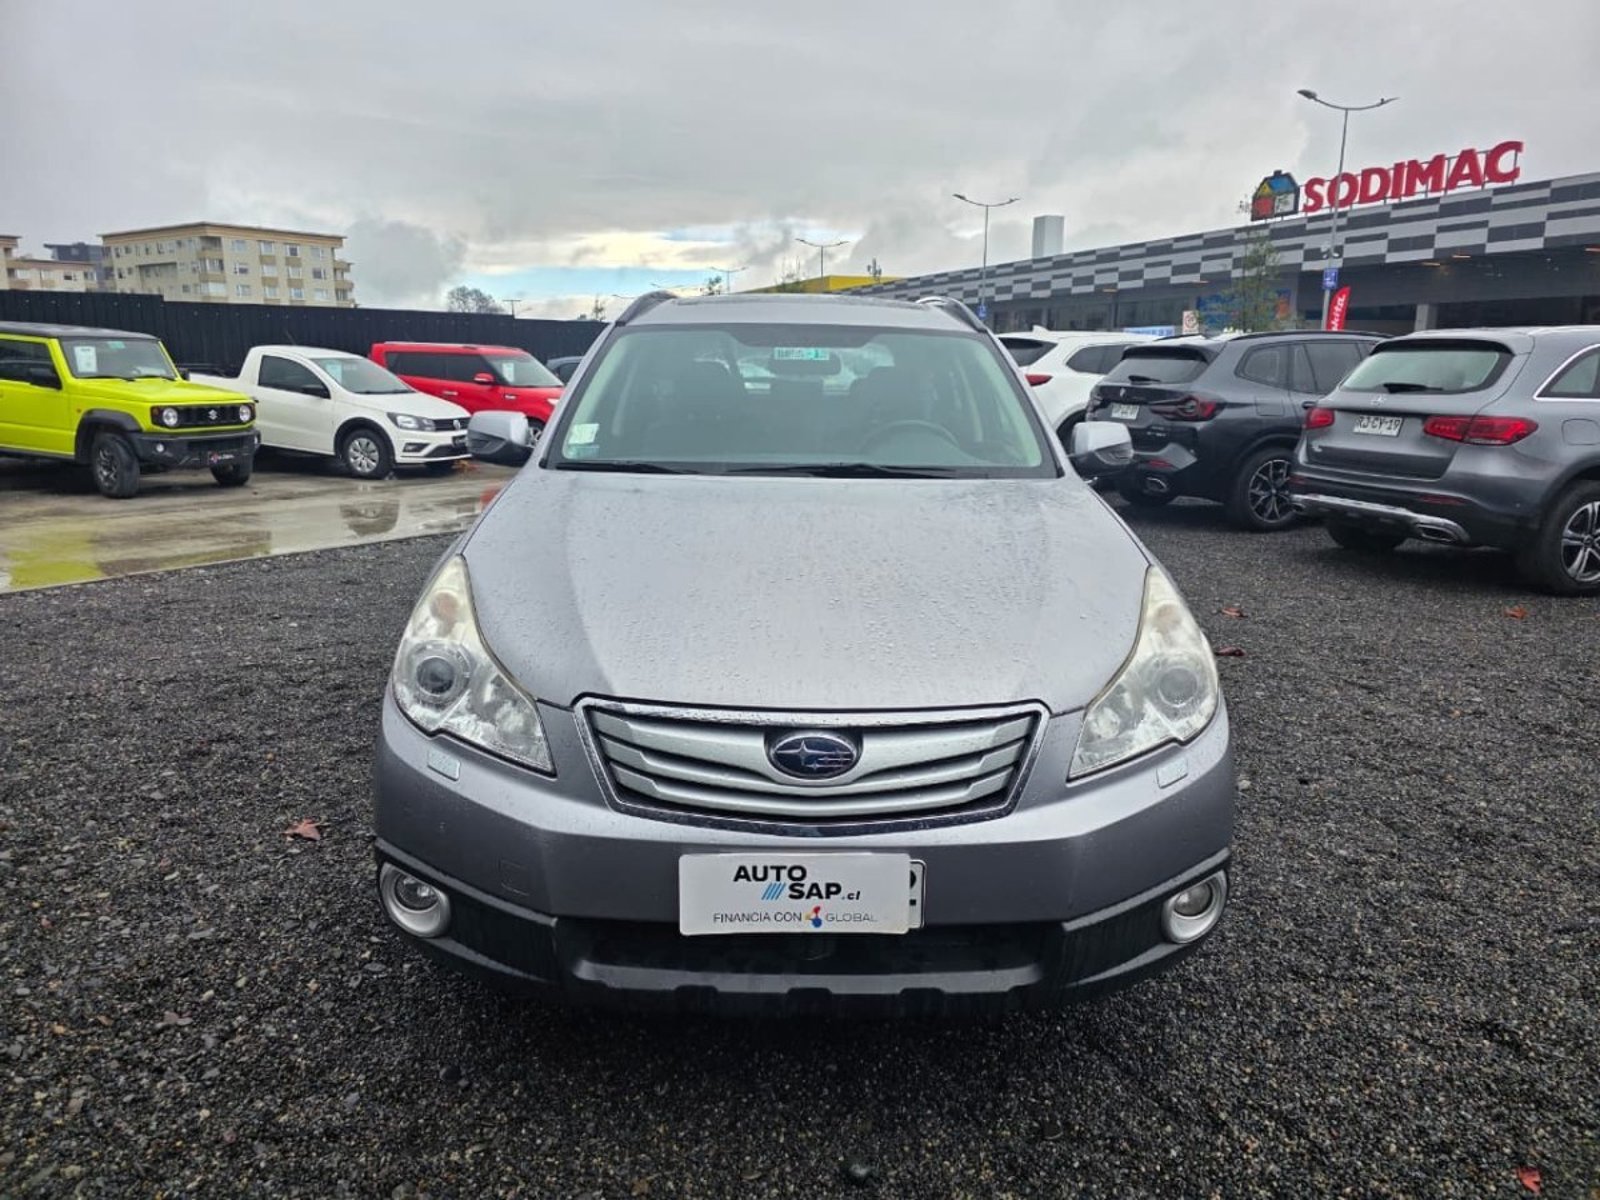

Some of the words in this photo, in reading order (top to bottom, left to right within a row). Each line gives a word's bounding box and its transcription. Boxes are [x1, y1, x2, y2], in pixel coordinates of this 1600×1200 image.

[1303, 141, 1523, 213] SODIMAC
[733, 865, 807, 882] AUTO
[713, 912, 771, 923] FINANCIA
[774, 912, 802, 921] CON
[825, 914, 878, 922] GLOBAL
